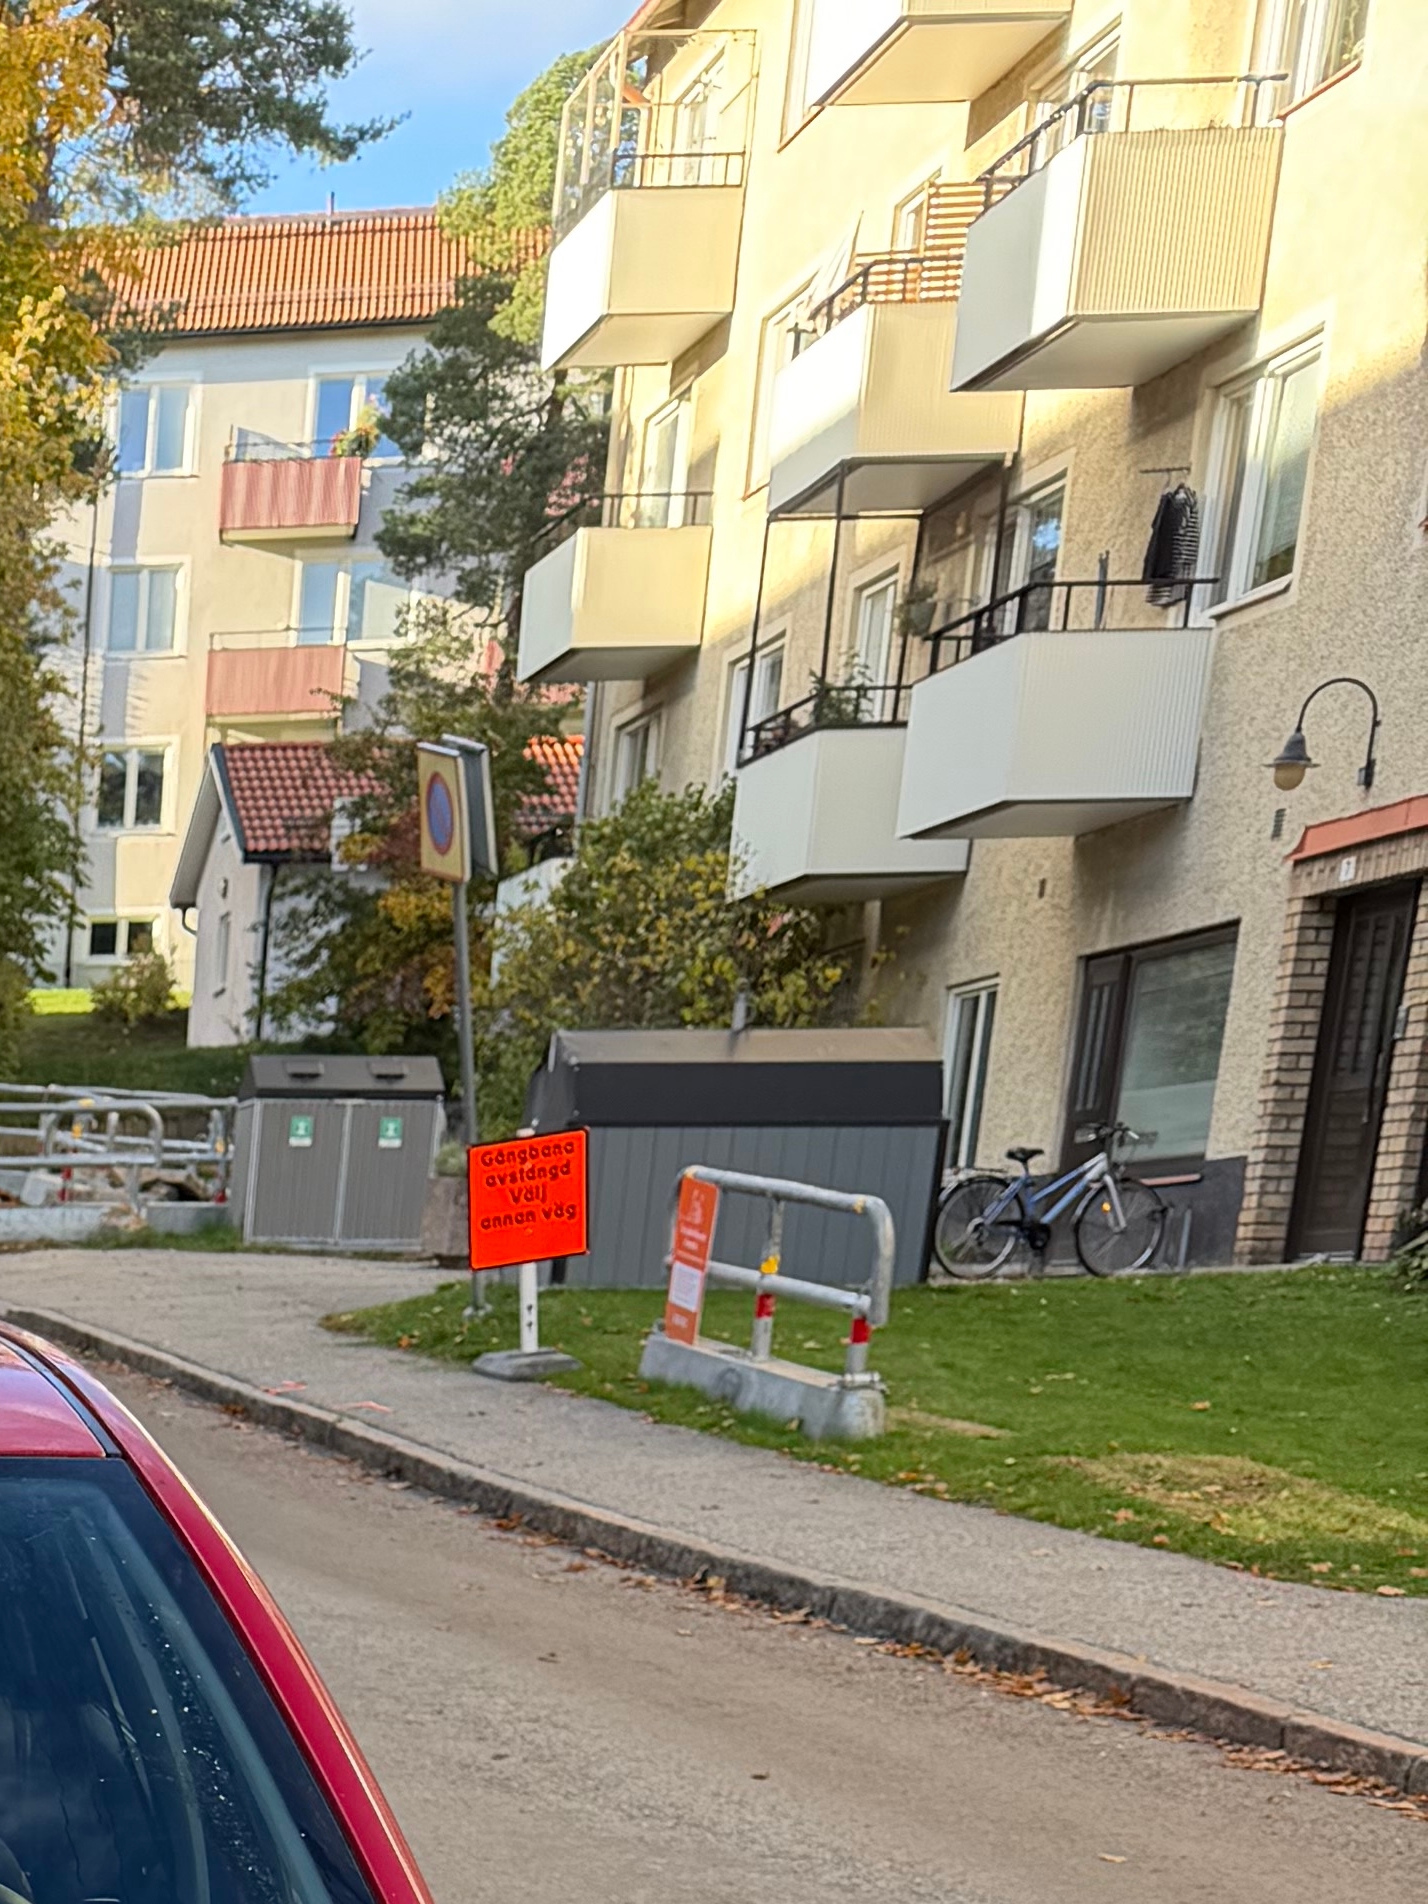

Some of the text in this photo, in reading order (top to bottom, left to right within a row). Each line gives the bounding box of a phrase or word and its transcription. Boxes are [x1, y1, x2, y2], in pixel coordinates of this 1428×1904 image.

[480, 1141, 575, 1168] Gångbana
[485, 1159, 572, 1188] avstängd
[508, 1182, 548, 1205] Välj
[480, 1200, 578, 1230] annan väg
